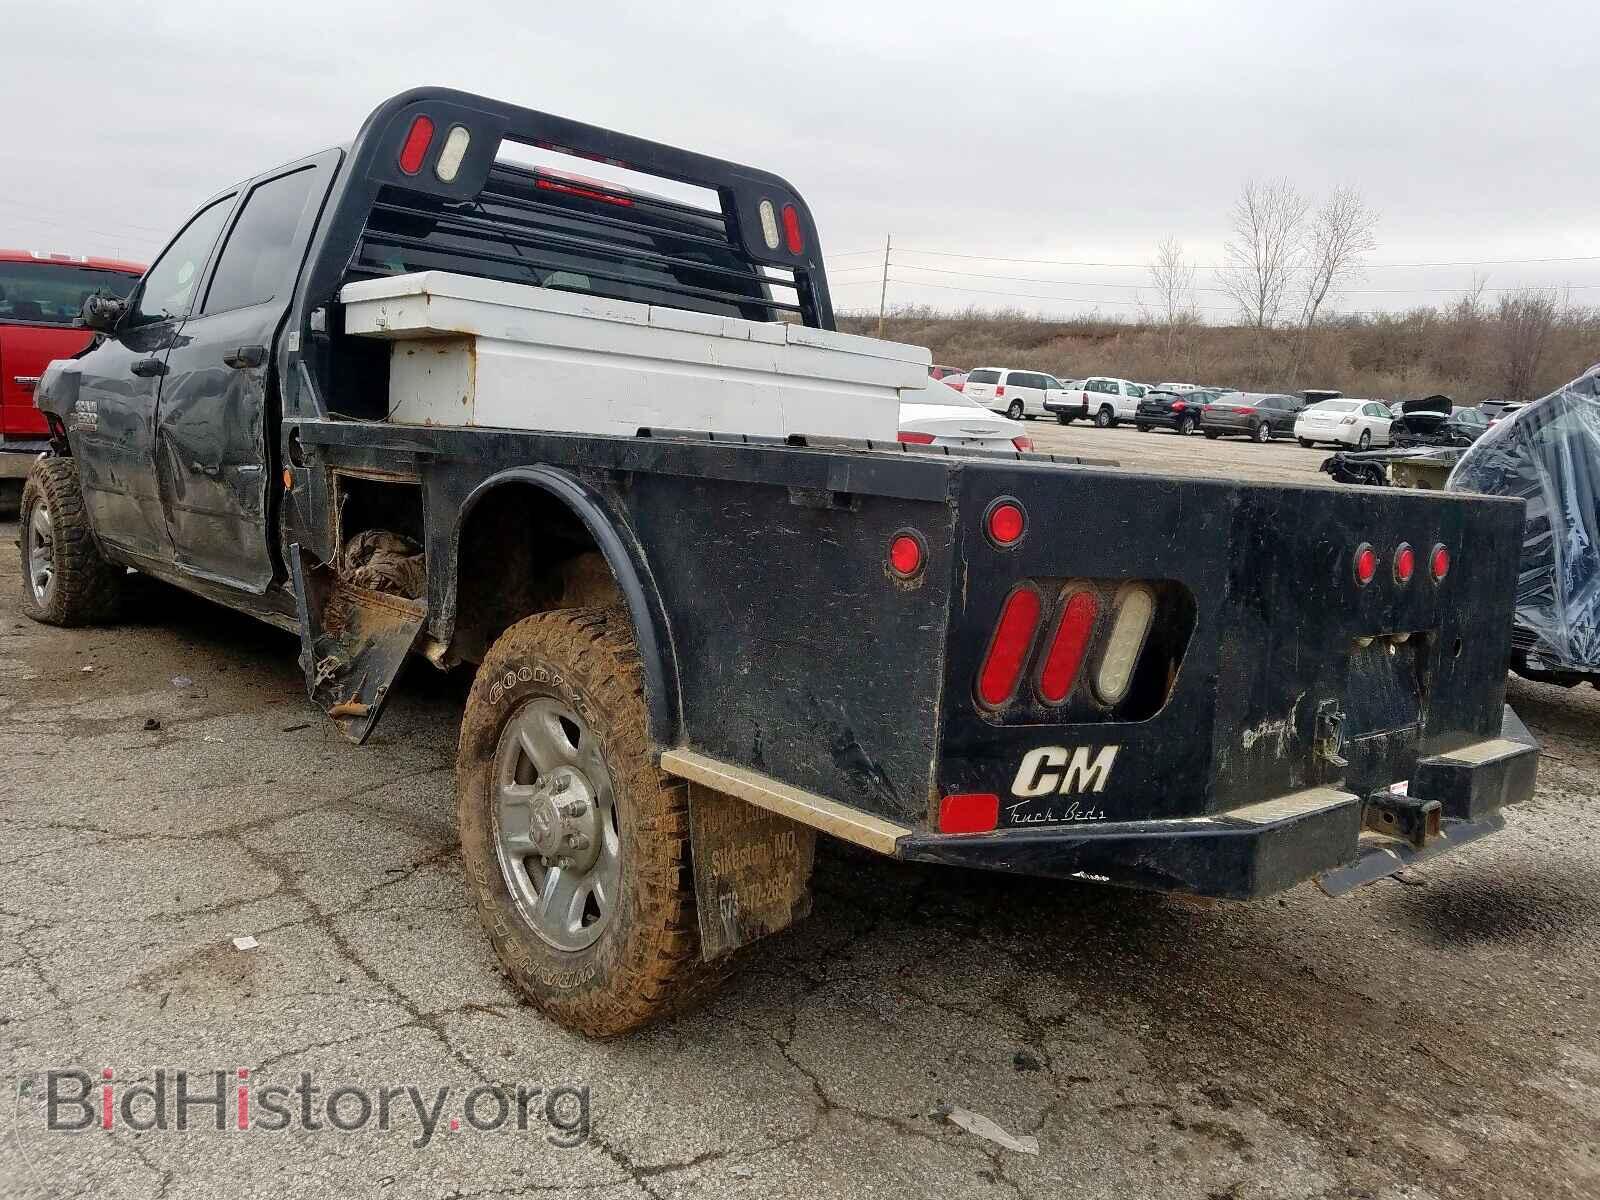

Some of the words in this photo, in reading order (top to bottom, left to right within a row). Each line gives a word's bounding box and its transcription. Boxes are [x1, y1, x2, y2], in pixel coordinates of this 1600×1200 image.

[1010, 745, 1120, 797] CM
[1006, 799, 1058, 823] Truck
[1060, 801, 1107, 821] Beds
